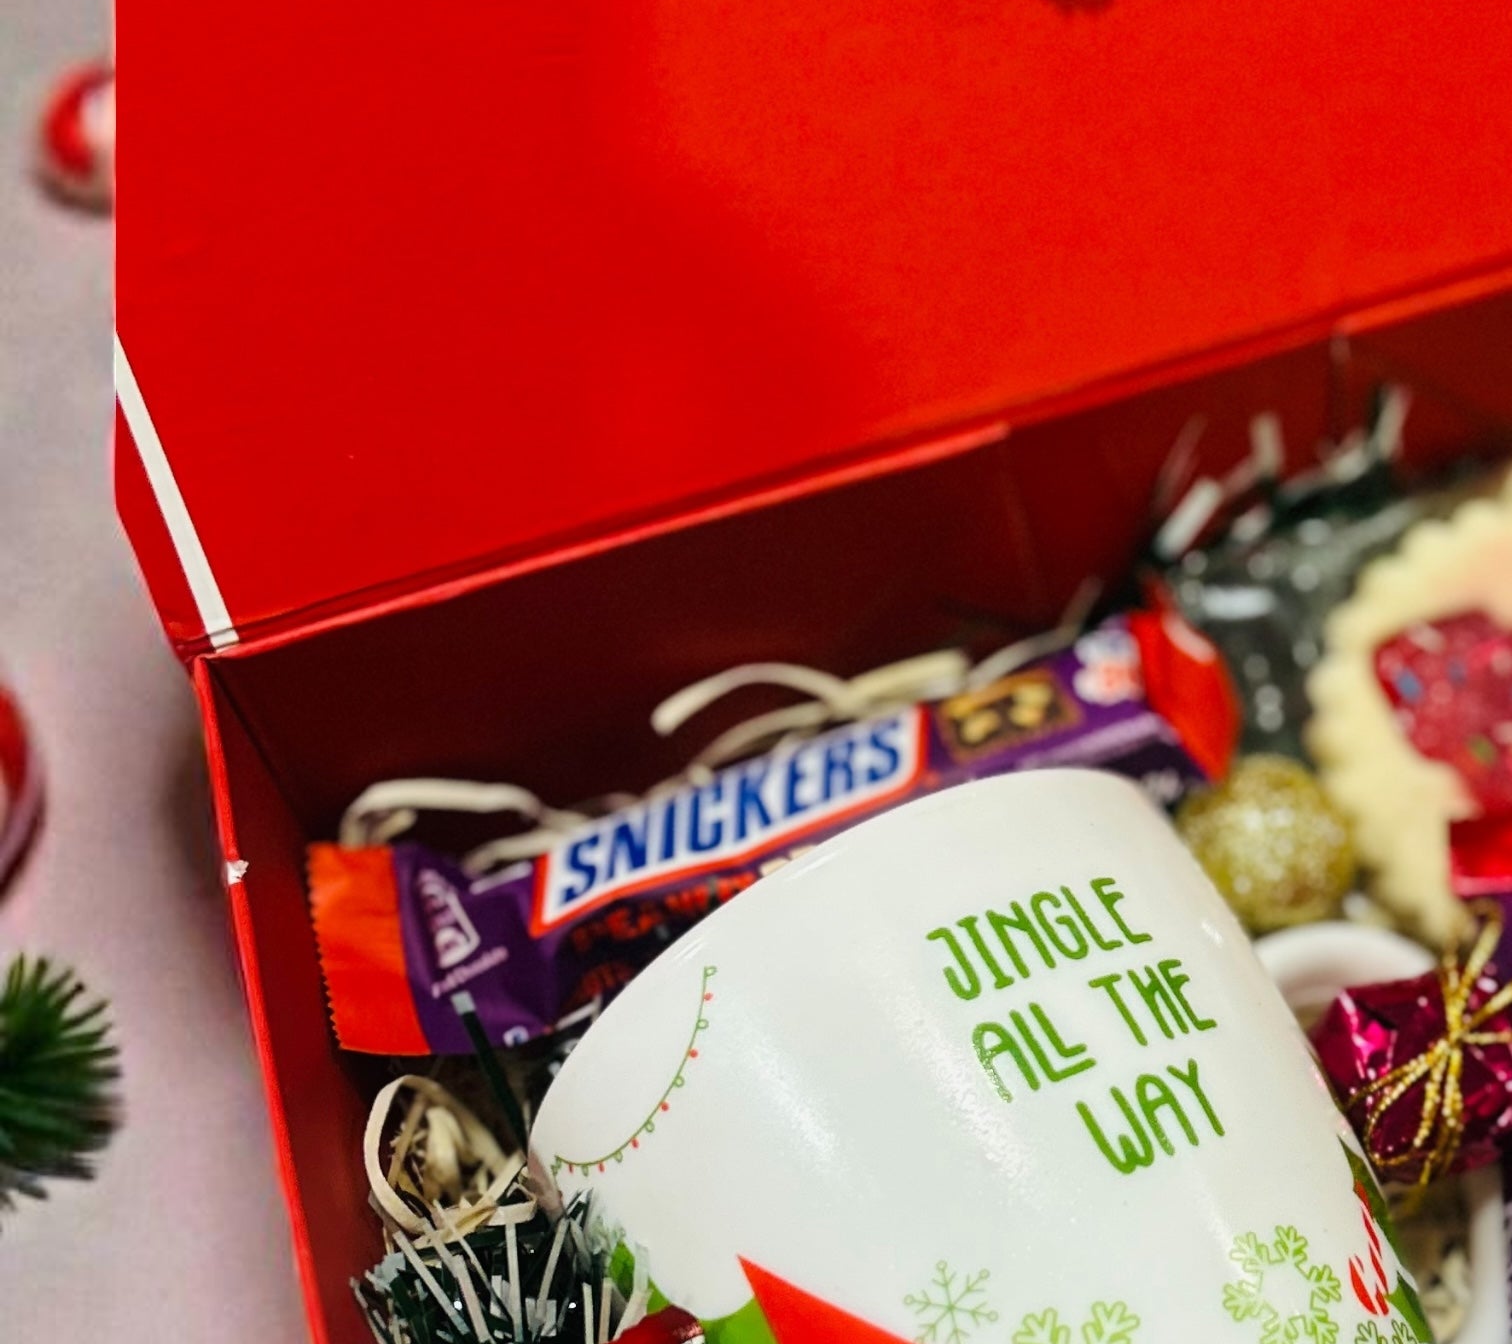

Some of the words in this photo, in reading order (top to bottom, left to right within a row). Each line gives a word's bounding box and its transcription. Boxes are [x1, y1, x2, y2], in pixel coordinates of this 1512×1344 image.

[560, 717, 902, 906] SNICKERS
[926, 877, 1153, 1001] JINGLE
[972, 1002, 1097, 1103] ALL
[1088, 958, 1218, 1047] THE
[1075, 1058, 1225, 1174] WAY
